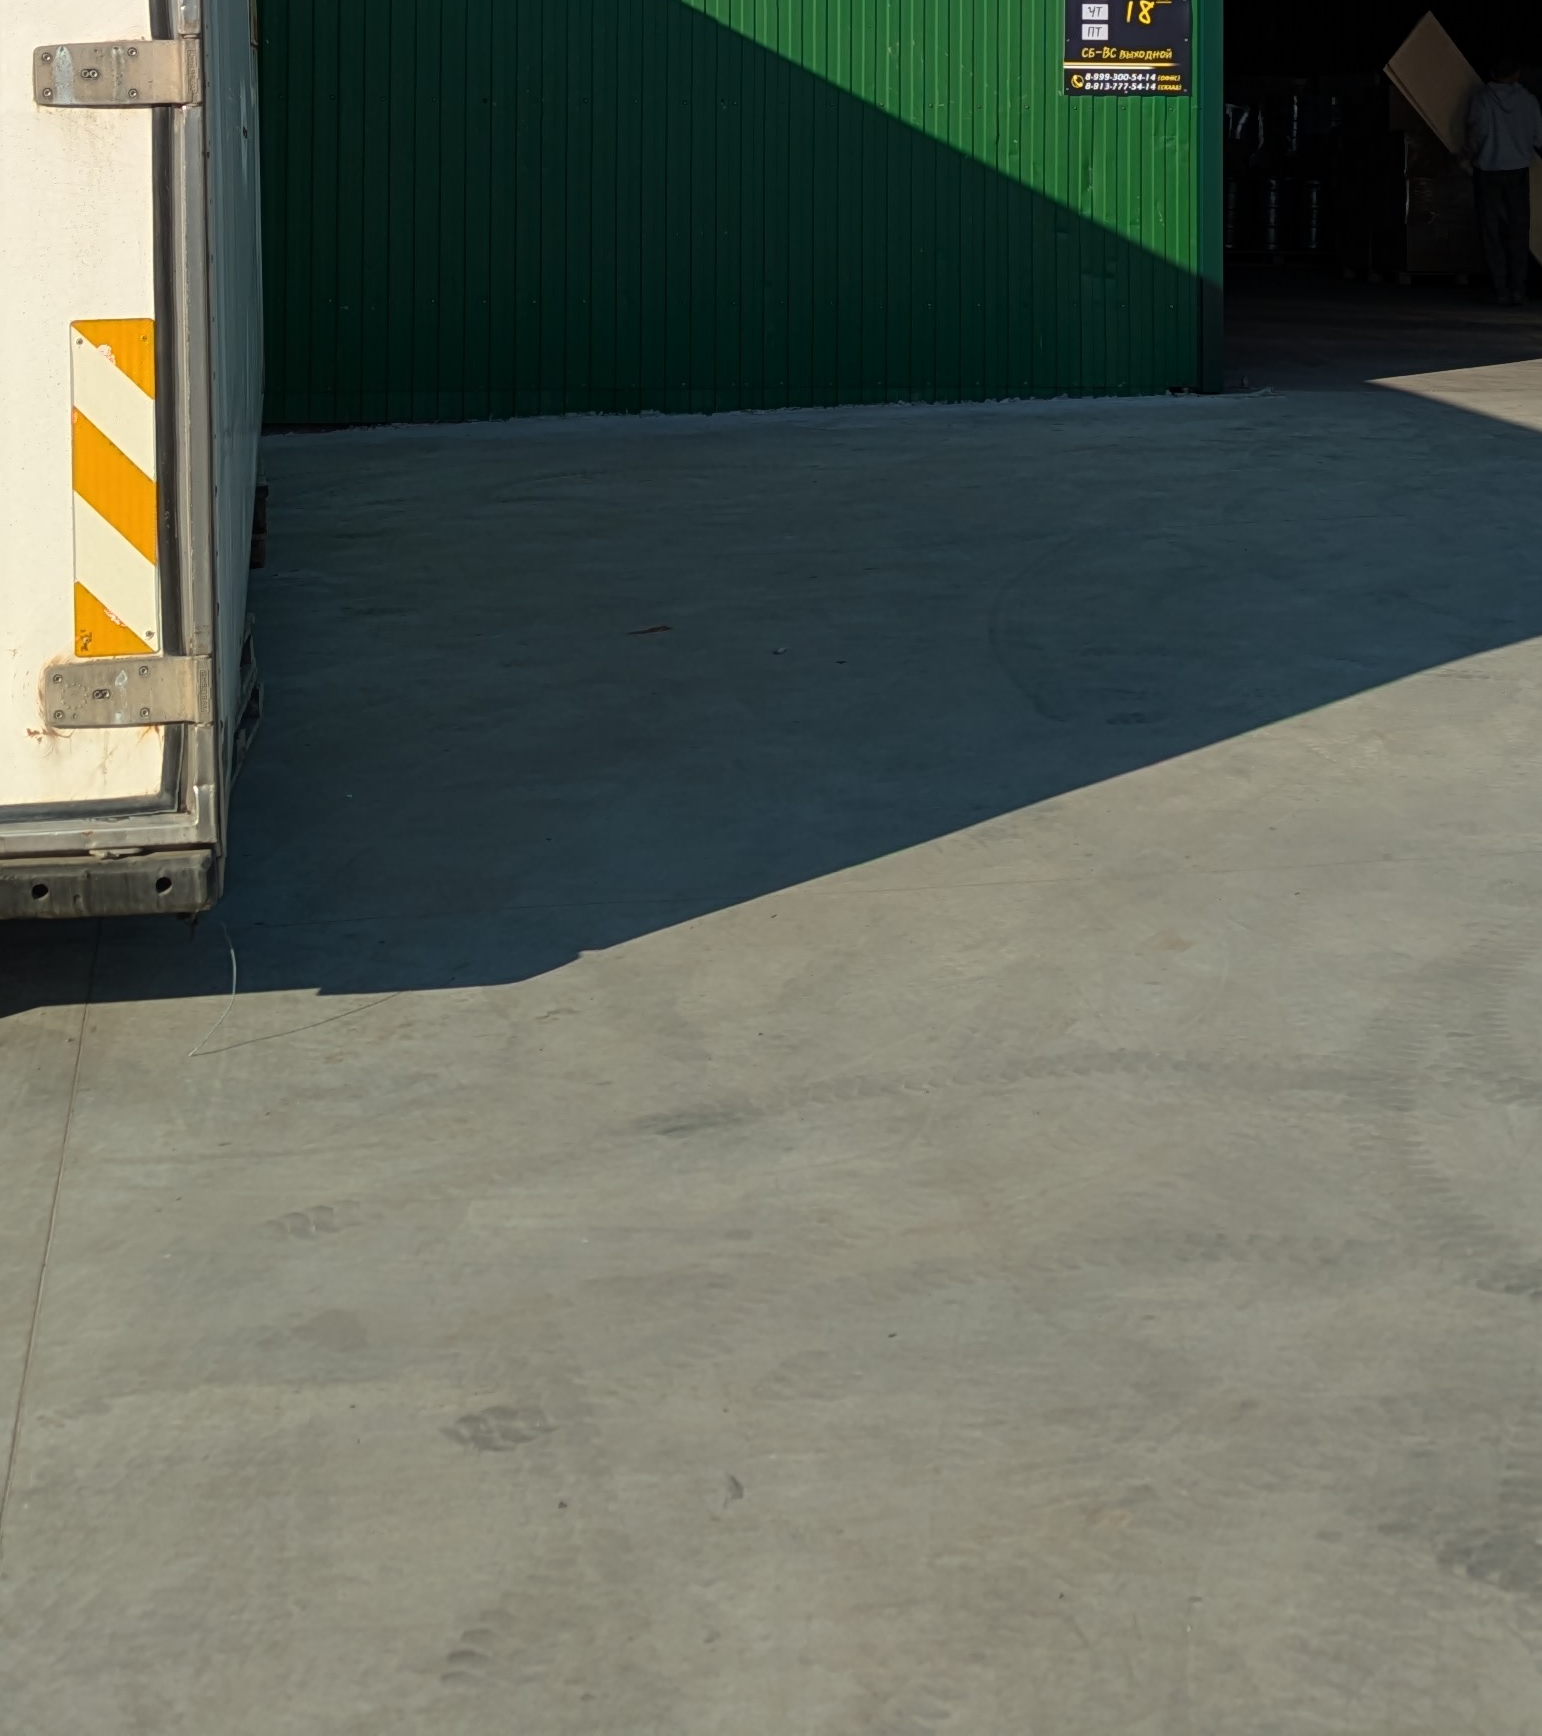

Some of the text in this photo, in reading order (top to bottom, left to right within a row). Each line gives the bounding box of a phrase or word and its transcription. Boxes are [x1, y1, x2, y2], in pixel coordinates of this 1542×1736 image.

[1087, 6, 1104, 18] ЧТ
[1126, 0, 1155, 25] 18
[1087, 26, 1103, 38] ПТ
